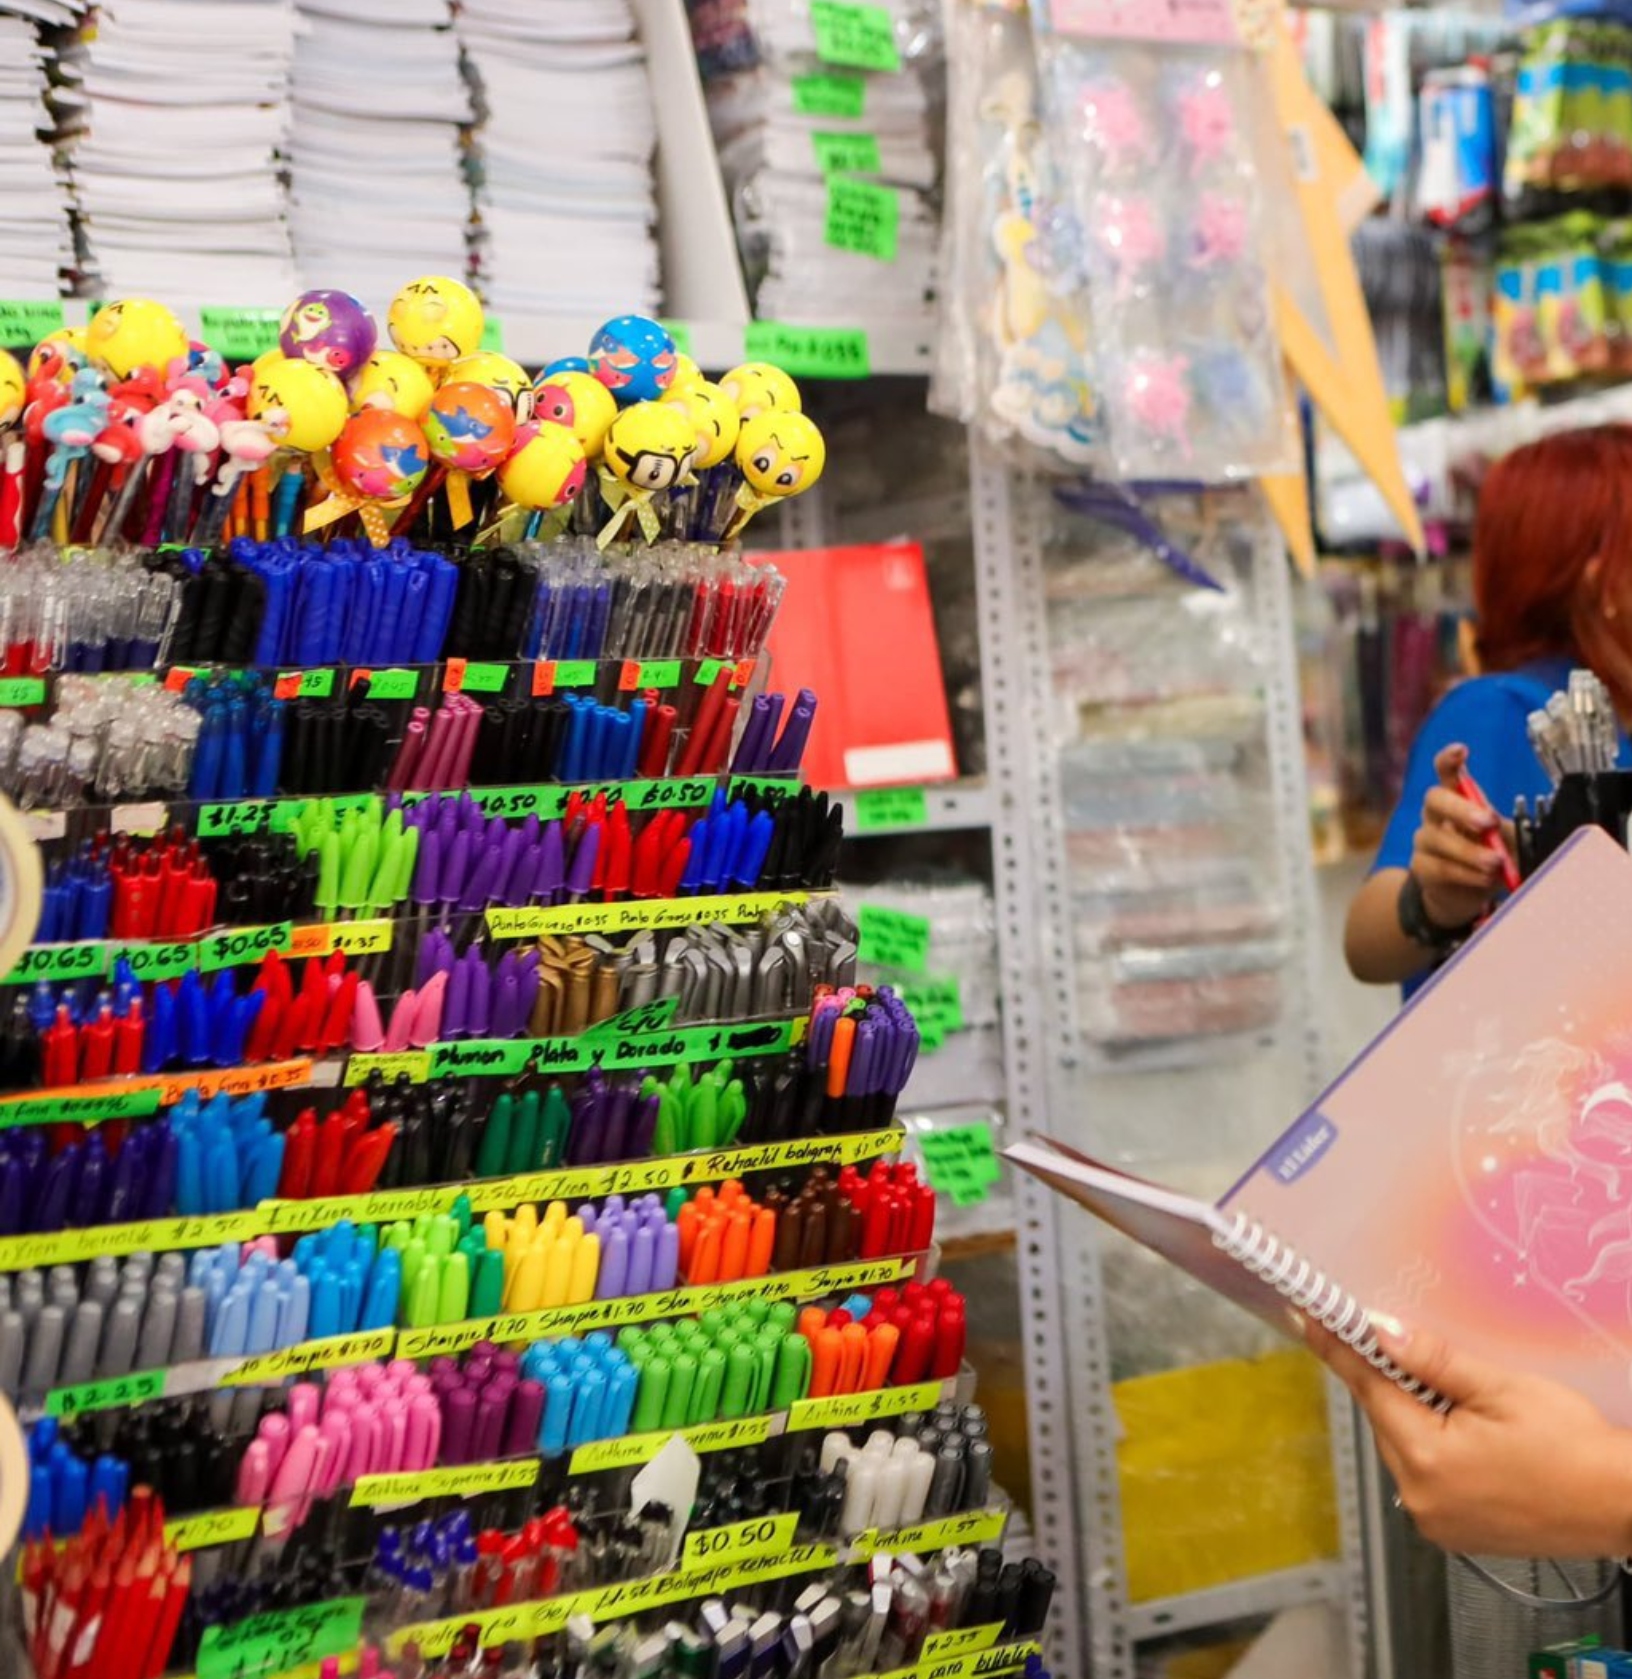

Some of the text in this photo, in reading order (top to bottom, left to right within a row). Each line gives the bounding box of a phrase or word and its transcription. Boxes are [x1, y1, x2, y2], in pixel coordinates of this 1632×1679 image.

[640, 783, 707, 806] $0.50
[213, 928, 288, 960] $0.65
[15, 945, 95, 972] $0.65
[616, 1039, 686, 1060] Dorado
[690, 1520, 776, 1557] $0.50
